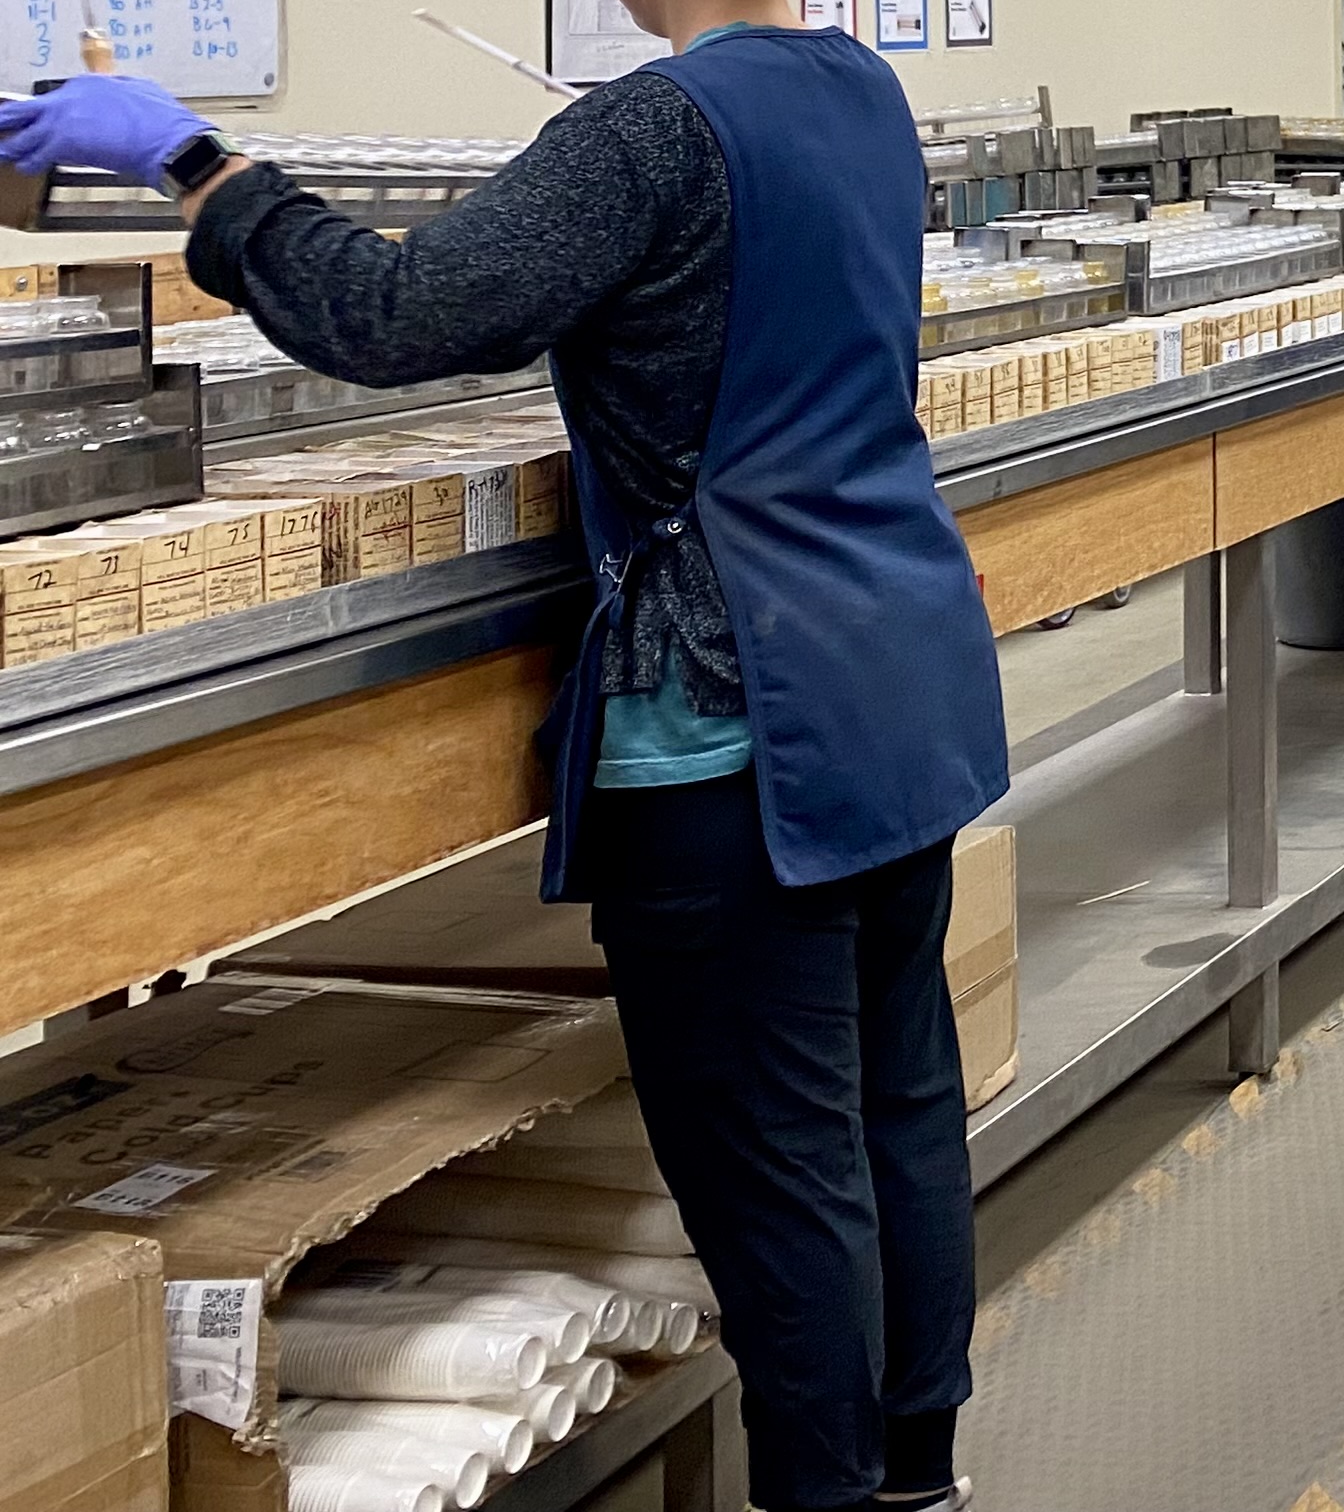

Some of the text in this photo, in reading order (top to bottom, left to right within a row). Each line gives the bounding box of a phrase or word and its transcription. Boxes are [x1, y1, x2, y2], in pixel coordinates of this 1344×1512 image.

[228, 524, 249, 545] 75
[164, 534, 190, 558] 74
[28, 570, 57, 590] 72
